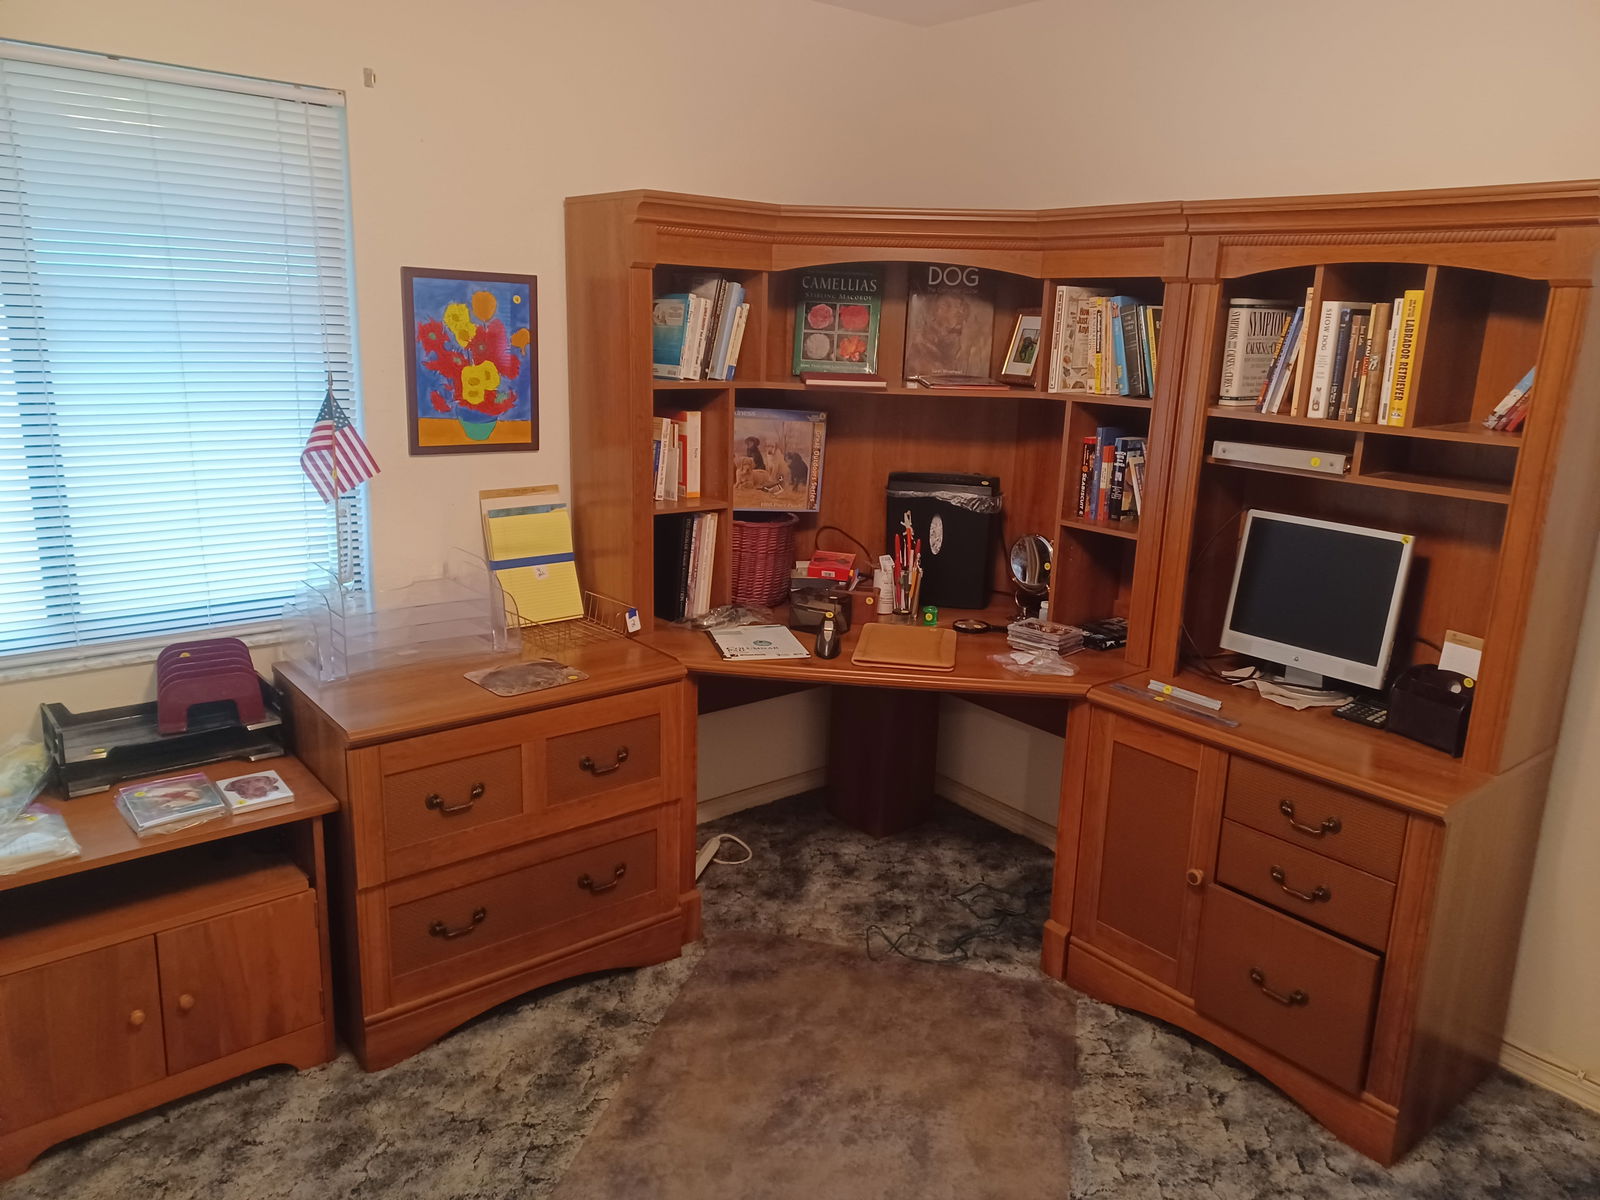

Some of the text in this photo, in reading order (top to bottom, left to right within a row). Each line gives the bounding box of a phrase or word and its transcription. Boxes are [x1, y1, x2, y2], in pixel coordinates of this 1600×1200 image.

[802, 276, 877, 292] CAMELLIAS
[928, 266, 979, 287] DOG
[1230, 311, 1241, 340] SYMPTOMS
[1323, 308, 1332, 334] SHOW
[1401, 319, 1415, 359] LABRADOR
[1393, 361, 1409, 401] RETRIEVER
[811, 451, 820, 480] Outdoors
[809, 482, 818, 502] Series
[1079, 472, 1088, 510] SEABISCUIT
